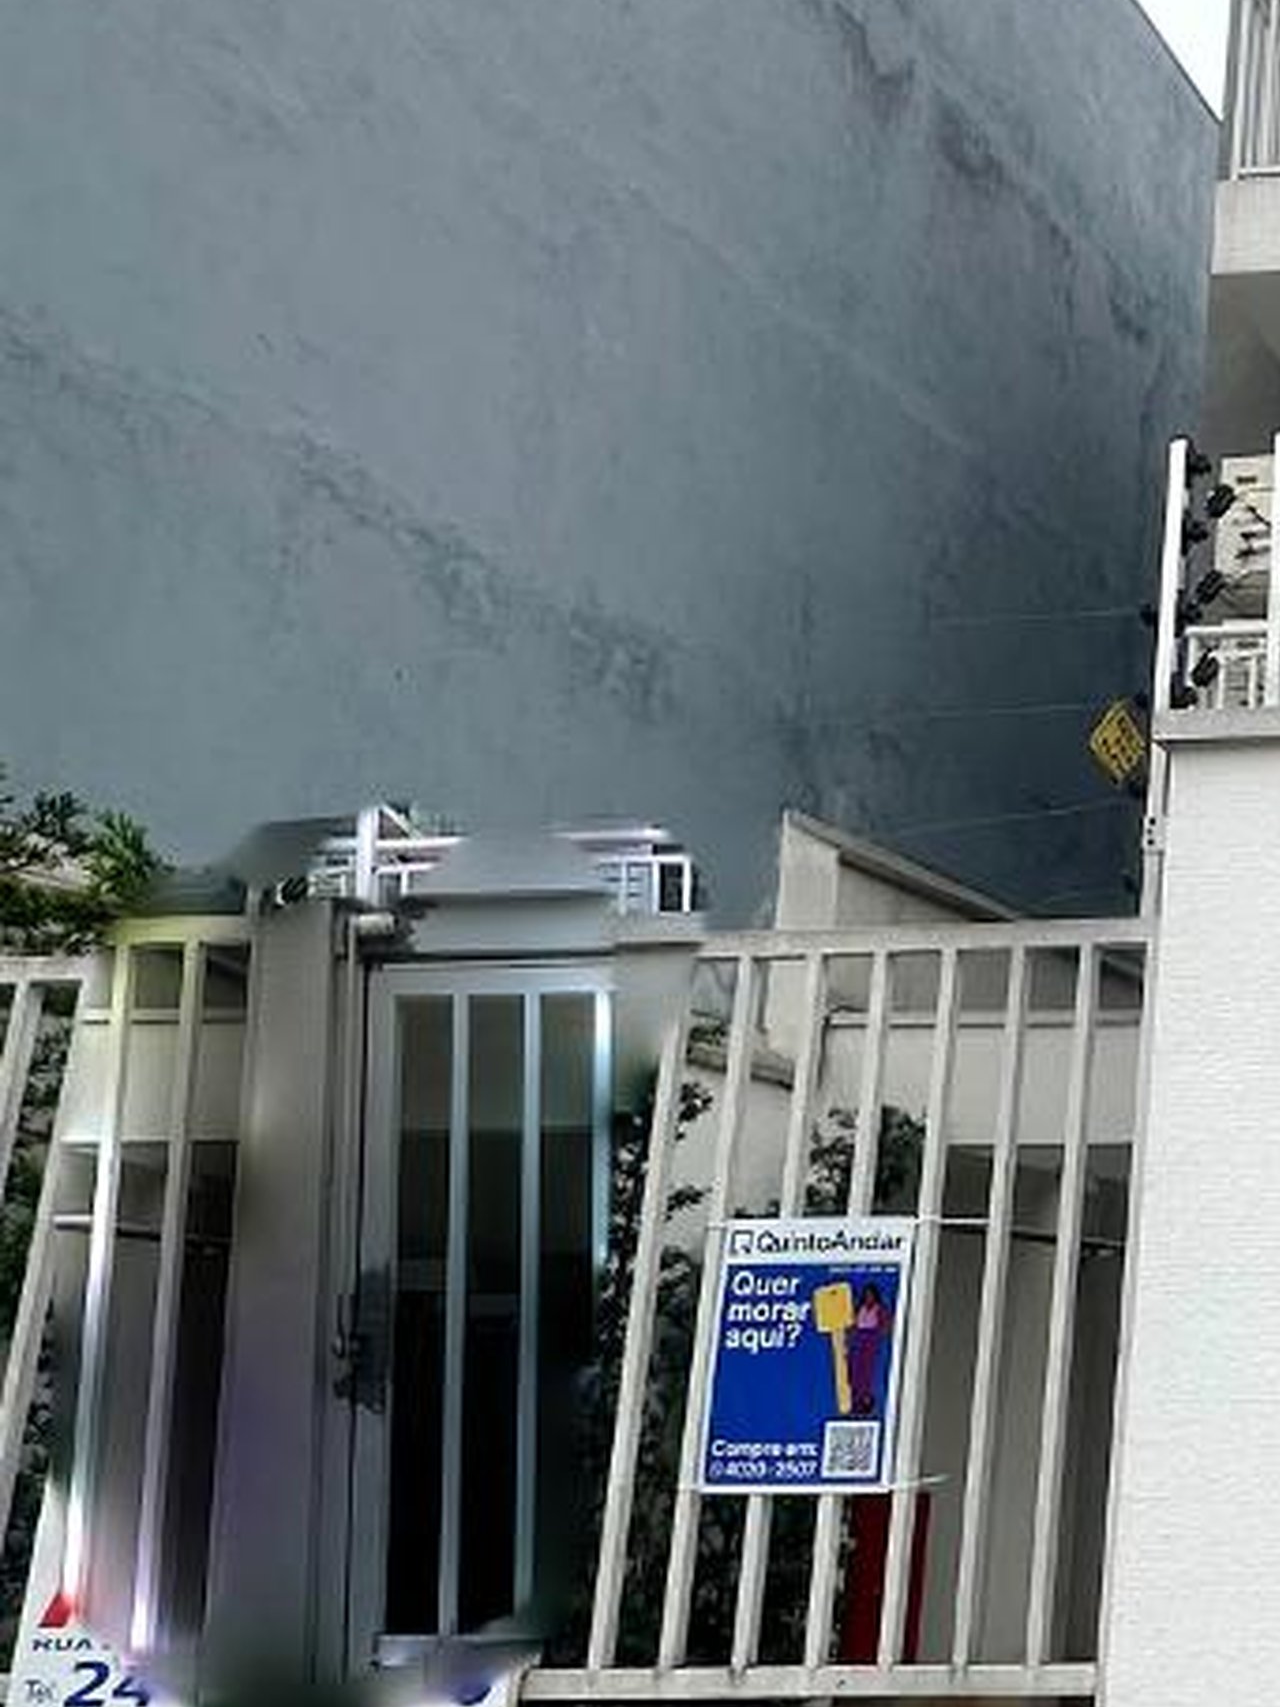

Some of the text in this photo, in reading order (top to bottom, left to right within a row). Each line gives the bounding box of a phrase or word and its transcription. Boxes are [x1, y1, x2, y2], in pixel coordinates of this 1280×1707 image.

[757, 1230, 904, 1253] QuintoAndar
[732, 1271, 800, 1296] Quer
[726, 1302, 811, 1322] morar
[725, 1323, 801, 1354] aqui?
